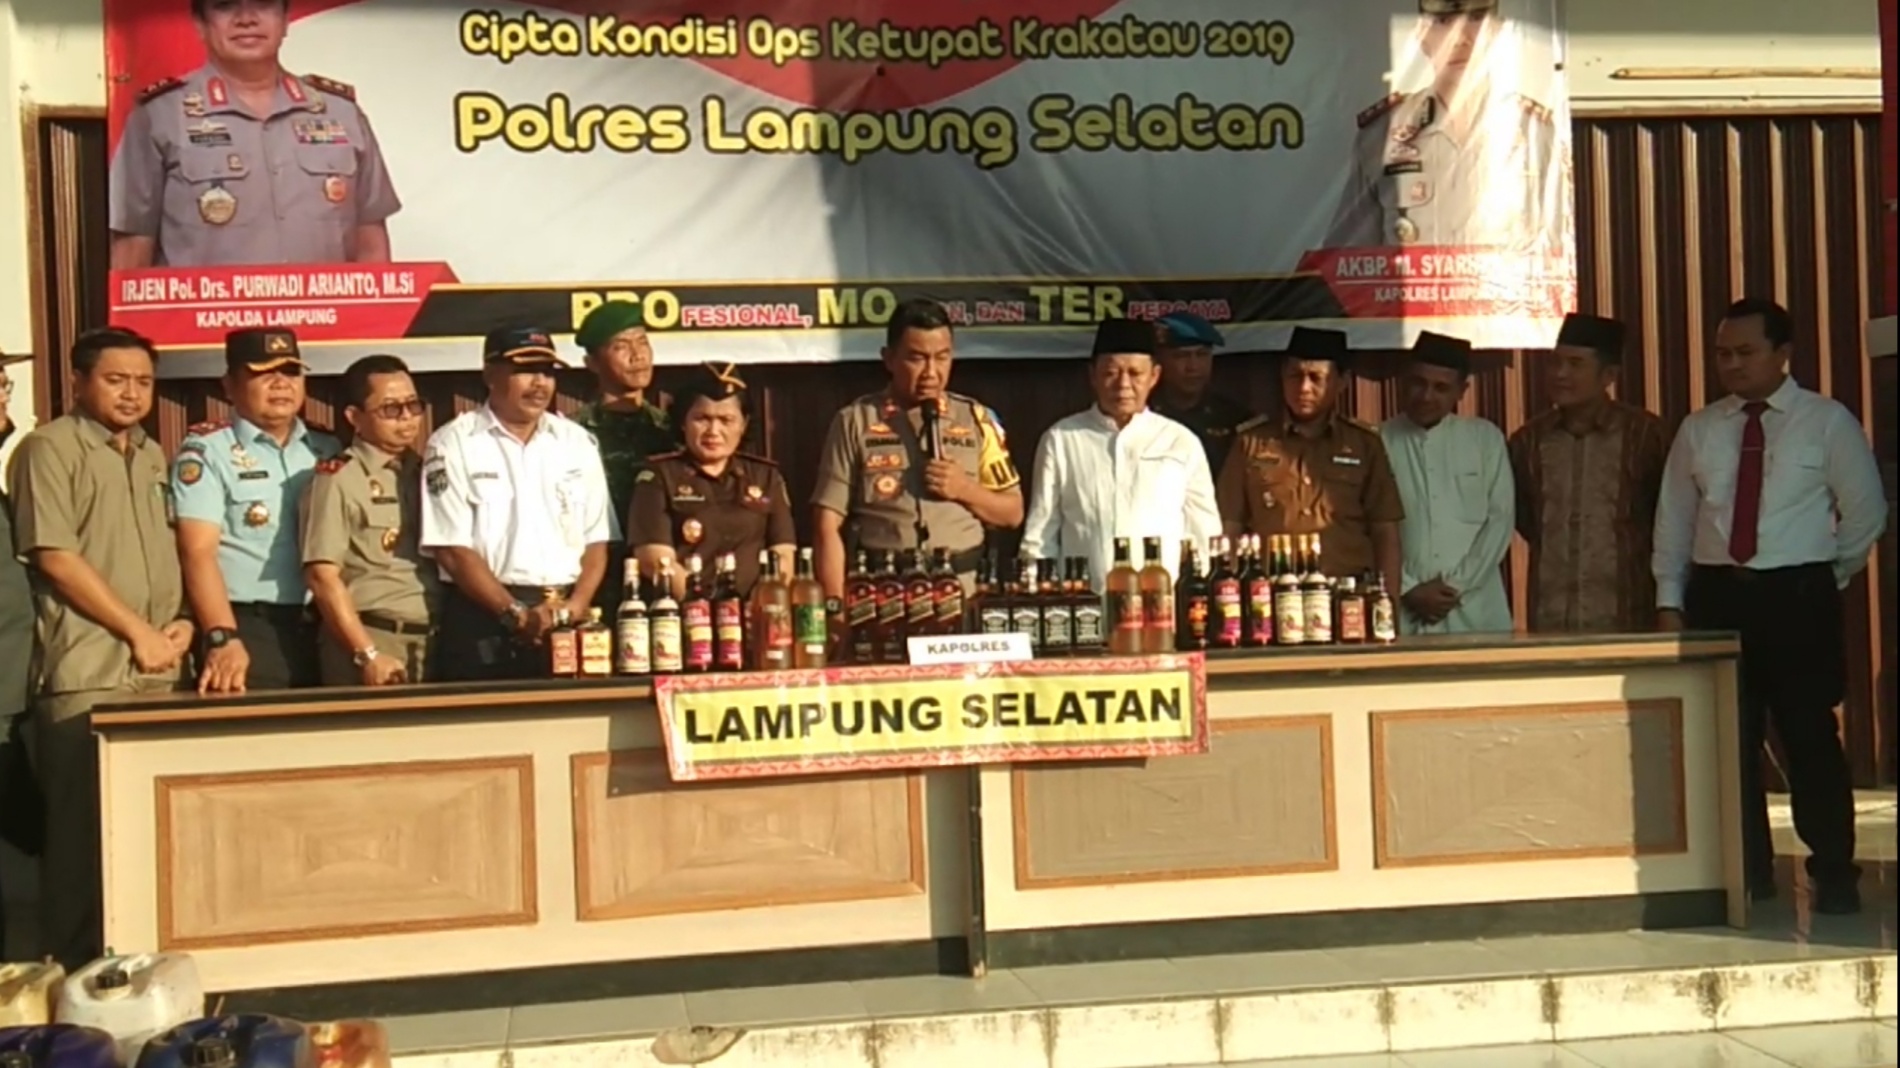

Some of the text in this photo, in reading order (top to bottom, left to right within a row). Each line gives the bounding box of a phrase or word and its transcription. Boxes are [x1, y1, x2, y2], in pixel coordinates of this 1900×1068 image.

[460, 11, 1296, 67] Cipta Kondisi Ops Ketupat Krakatau 2019
[454, 91, 1304, 170] Polres Lampung Selatan
[1335, 256, 1390, 278] AKBP.
[122, 272, 415, 302] IRJEN Pol. Drs. PURWADI ARIANTO, M.Si
[1374, 286, 1439, 303] KAPOLRES
[196, 308, 338, 328] KAPOLDA LAMPUNG
[976, 301, 1025, 322] DAN
[927, 640, 1011, 656] KAPOLRES
[685, 687, 1182, 745] LAMPUNG SELATAN
